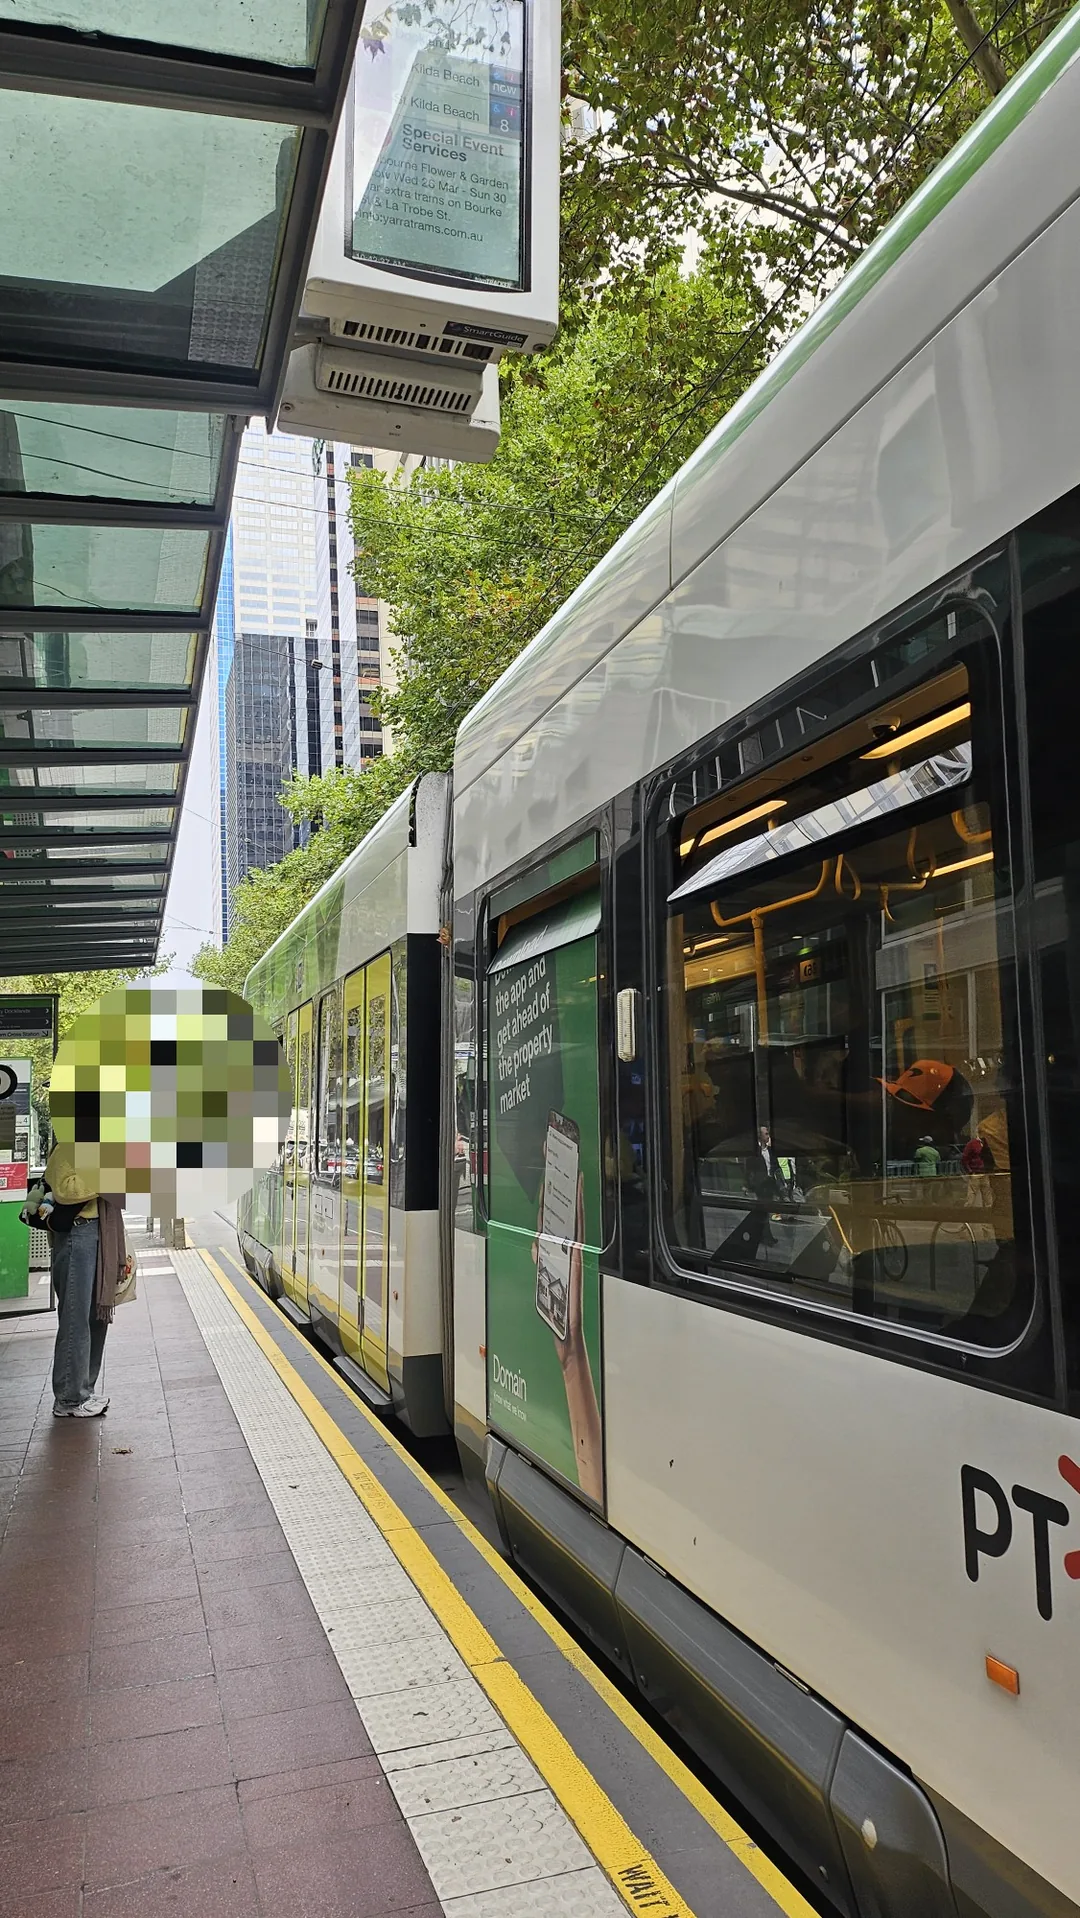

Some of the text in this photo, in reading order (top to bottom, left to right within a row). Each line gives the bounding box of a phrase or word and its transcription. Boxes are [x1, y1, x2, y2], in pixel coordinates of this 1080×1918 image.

[411, 62, 440, 79] Kilda
[443, 69, 480, 87] Beach
[410, 97, 440, 113] Kilda
[443, 104, 480, 122] Beach
[500, 119, 510, 133] 8
[402, 124, 505, 157] Special Event
[402, 138, 467, 162] Services
[394, 173, 418, 186] Wed
[421, 177, 436, 189] 26
[438, 181, 460, 194] Mar
[469, 188, 490, 201] Sun
[493, 193, 507, 204] 30
[421, 163, 456, 179] Flower
[459, 172, 468, 181] &
[470, 174, 509, 190] Garden
[384, 186, 411, 199] extra
[414, 192, 445, 206] trams
[447, 200, 461, 209] on
[464, 200, 503, 217] Bourke
[385, 199, 399, 211] La
[400, 201, 434, 218] Trobe
[436, 209, 451, 221] St.
[463, 325, 524, 342] SmartGuide
[495, 955, 547, 1017] the app and
[497, 981, 550, 1055] get ahead of
[498, 1023, 553, 1081] the property
[500, 1073, 531, 1115] market
[493, 1353, 527, 1402] Domain
[617, 1864, 671, 1909] WAIT
